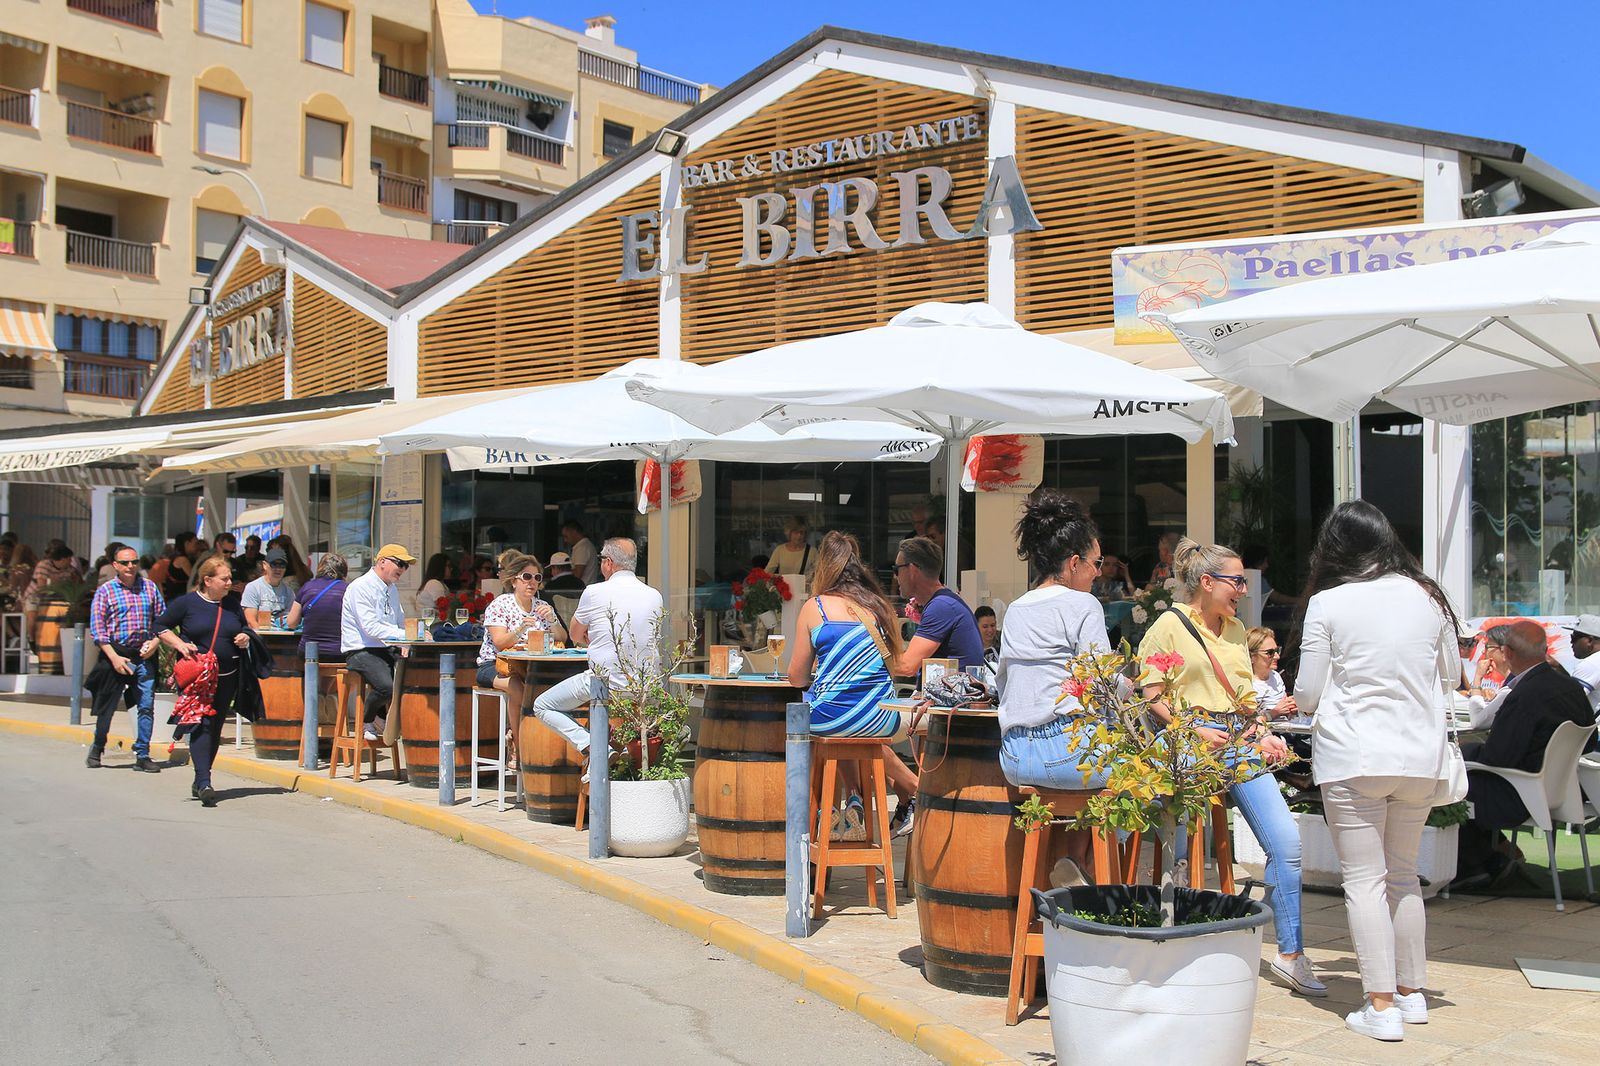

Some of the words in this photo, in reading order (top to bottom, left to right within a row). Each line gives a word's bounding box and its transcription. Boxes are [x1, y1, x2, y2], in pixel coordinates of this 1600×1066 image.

[681, 157, 737, 188] BAR
[741, 153, 766, 178] &
[770, 113, 982, 173] RESTAURANTE
[616, 204, 710, 283] EL
[736, 154, 1045, 269] BIRRA
[218, 298, 296, 376] BIRRA
